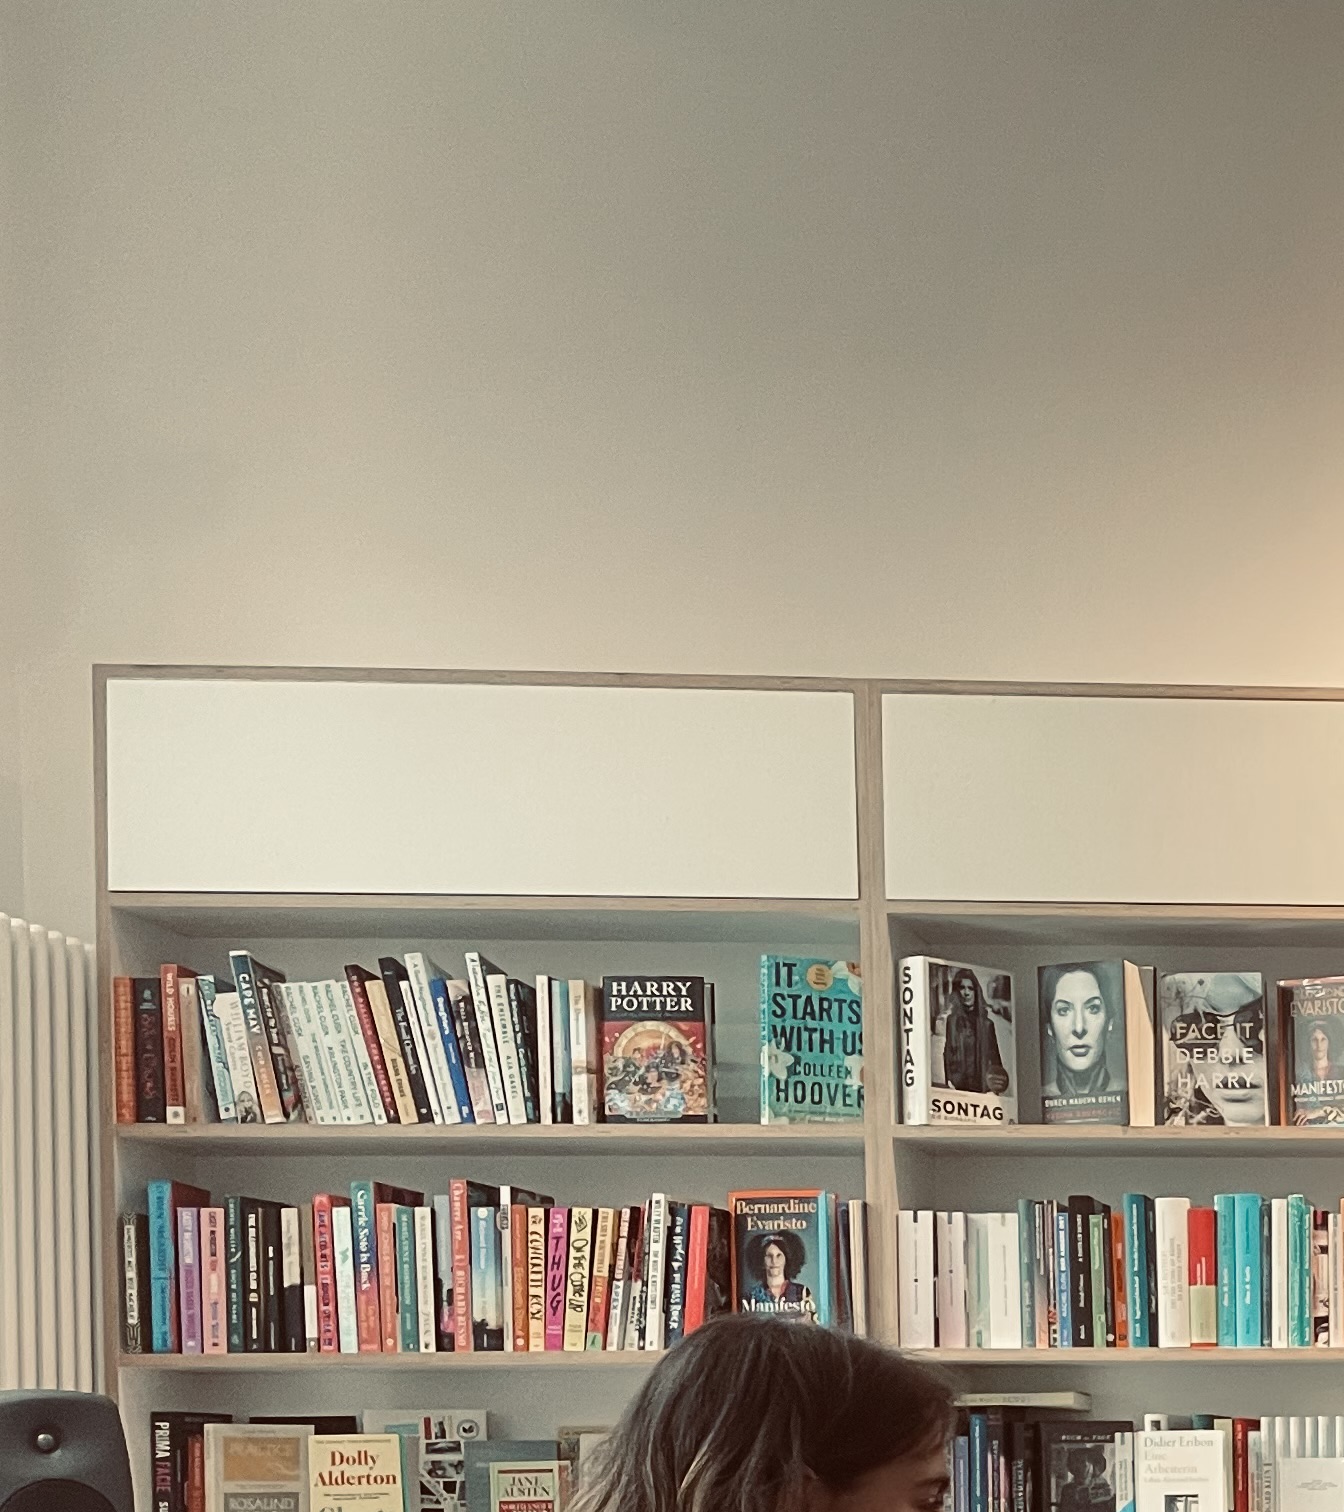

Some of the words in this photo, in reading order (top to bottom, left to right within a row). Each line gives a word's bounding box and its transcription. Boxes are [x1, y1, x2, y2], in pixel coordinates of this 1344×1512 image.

[774, 961, 798, 989] IT
[611, 981, 693, 997] HARRY
[238, 973, 254, 1007] CAPE
[246, 1008, 261, 1035] MAY
[609, 996, 695, 1012] POTTER
[770, 992, 862, 1025] STARTS
[901, 965, 915, 1089] SONTAG
[1175, 1023, 1225, 1040] FACE
[1236, 1023, 1254, 1039] IT
[771, 1024, 836, 1055] WITH
[1175, 1047, 1255, 1065] DEBBIE
[792, 1061, 853, 1079] COLLEEN
[1177, 1072, 1255, 1089] HARRY
[931, 1098, 1005, 1122] SONTAG
[356, 1190, 368, 1226] Carrie
[736, 1200, 817, 1215] Bernardine
[746, 1215, 807, 1231] Evaristo
[358, 1228, 369, 1251] Soto
[359, 1264, 371, 1291] Back
[549, 1235, 565, 1317] THUG
[741, 1297, 816, 1313] Manifesto
[154, 1421, 170, 1458] PRIMA
[1143, 1436, 1176, 1449] Didier
[1177, 1436, 1214, 1449] Eribon
[328, 1449, 380, 1470] Dolly
[155, 1461, 171, 1493] FACIE
[314, 1470, 397, 1488] Alderton
[509, 1475, 543, 1488] JANE
[500, 1486, 551, 1498] AUSTEN
[229, 1497, 295, 1510] ROSALIND
